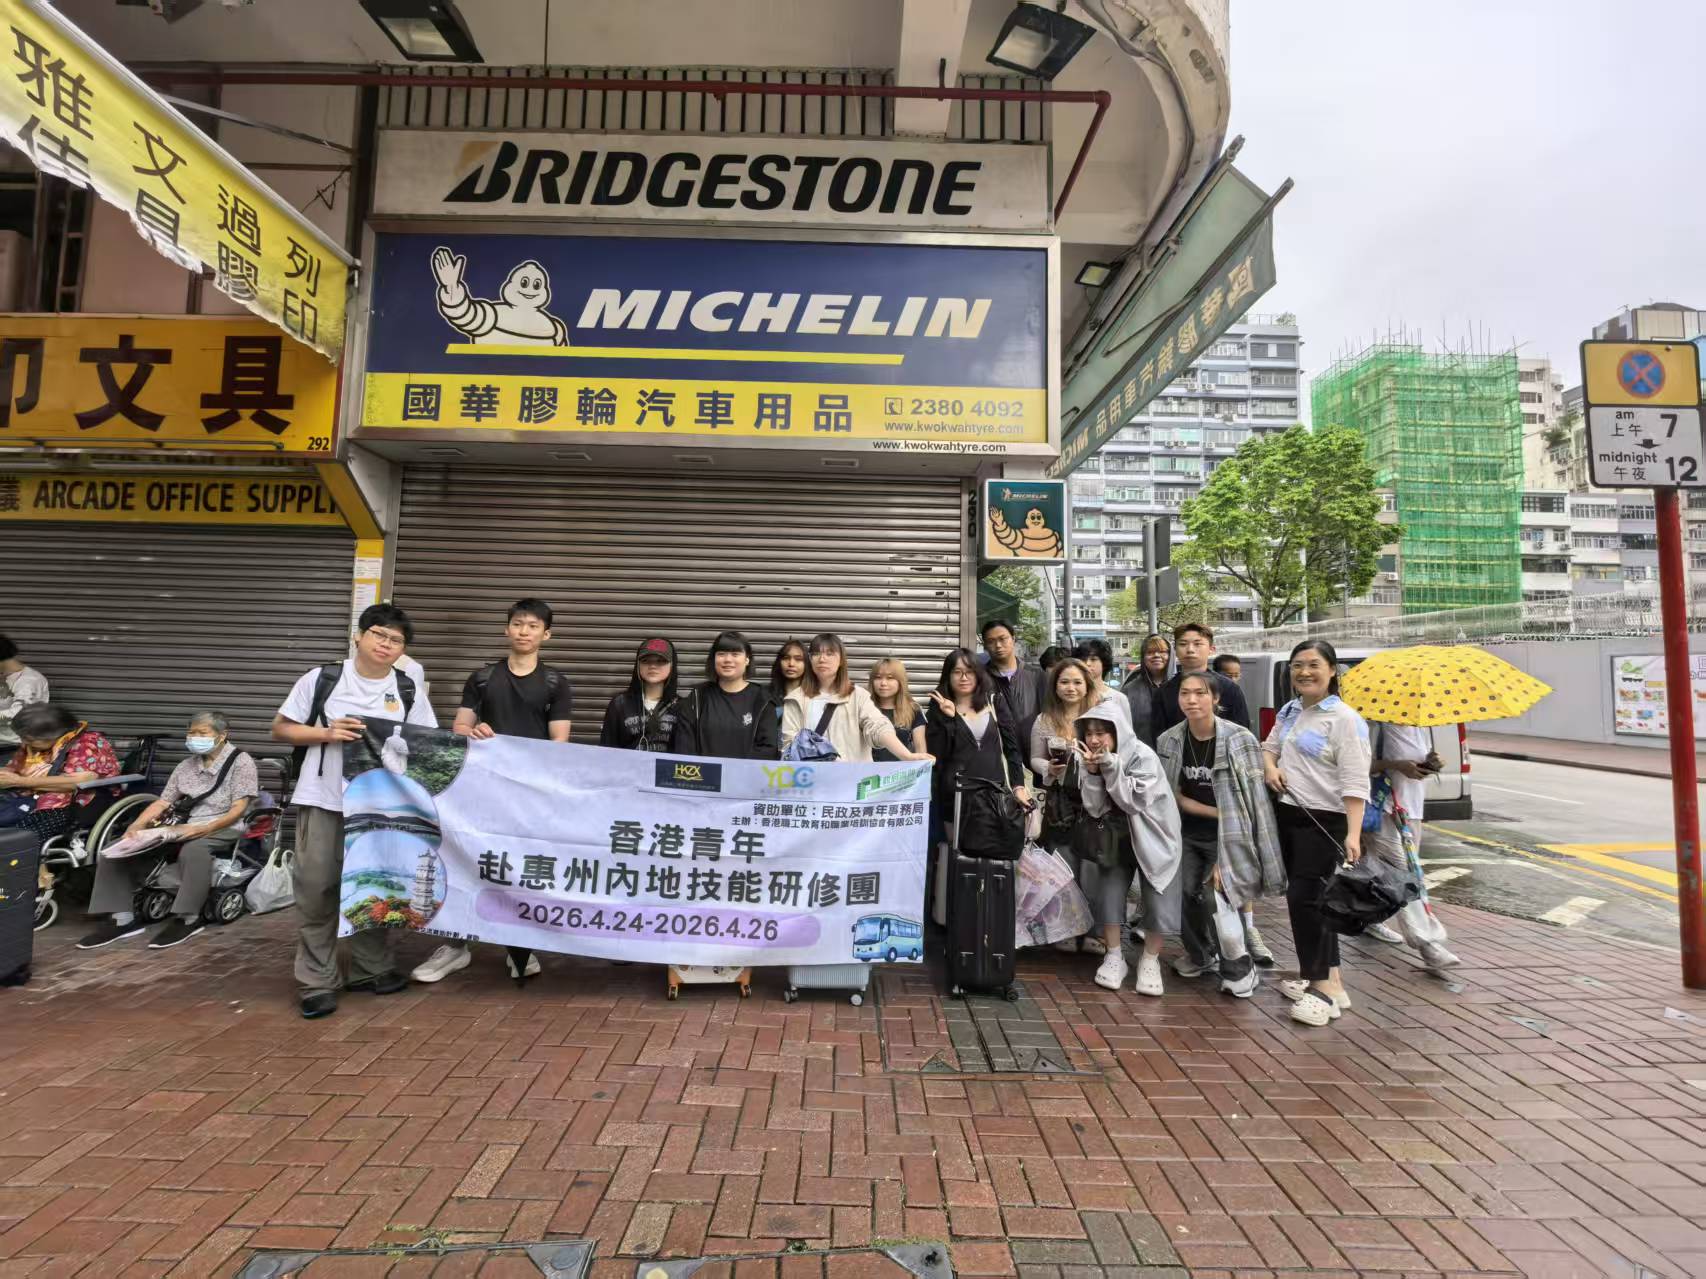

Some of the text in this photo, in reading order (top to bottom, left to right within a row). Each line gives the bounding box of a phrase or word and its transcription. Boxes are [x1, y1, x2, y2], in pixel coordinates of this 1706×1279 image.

[132, 121, 187, 251] 文具
[442, 140, 982, 216] BRIDGESTONE
[217, 184, 262, 300] 過膠
[284, 235, 321, 343] 列印
[576, 288, 994, 338] MICHELIN
[402, 383, 853, 433] 國華膠輪汽車用品
[910, 398, 1024, 417] 2380 4092
[1615, 410, 1678, 438] am 7
[307, 436, 330, 451] 292
[873, 440, 1006, 454] www.kwokwahtyre.com
[884, 420, 1024, 437] www.kwokwahtyre.com
[1610, 422, 1643, 437] 上午
[1599, 451, 1698, 482] midnight 12
[1613, 466, 1647, 481] 午夜
[33, 480, 136, 511] ARCADE
[146, 482, 234, 513] OFFICE
[609, 820, 766, 864] 香港青年
[477, 849, 881, 908] 赴惠州內地技能研修團
[518, 901, 779, 942] 2026.4.24-2026.4.26
